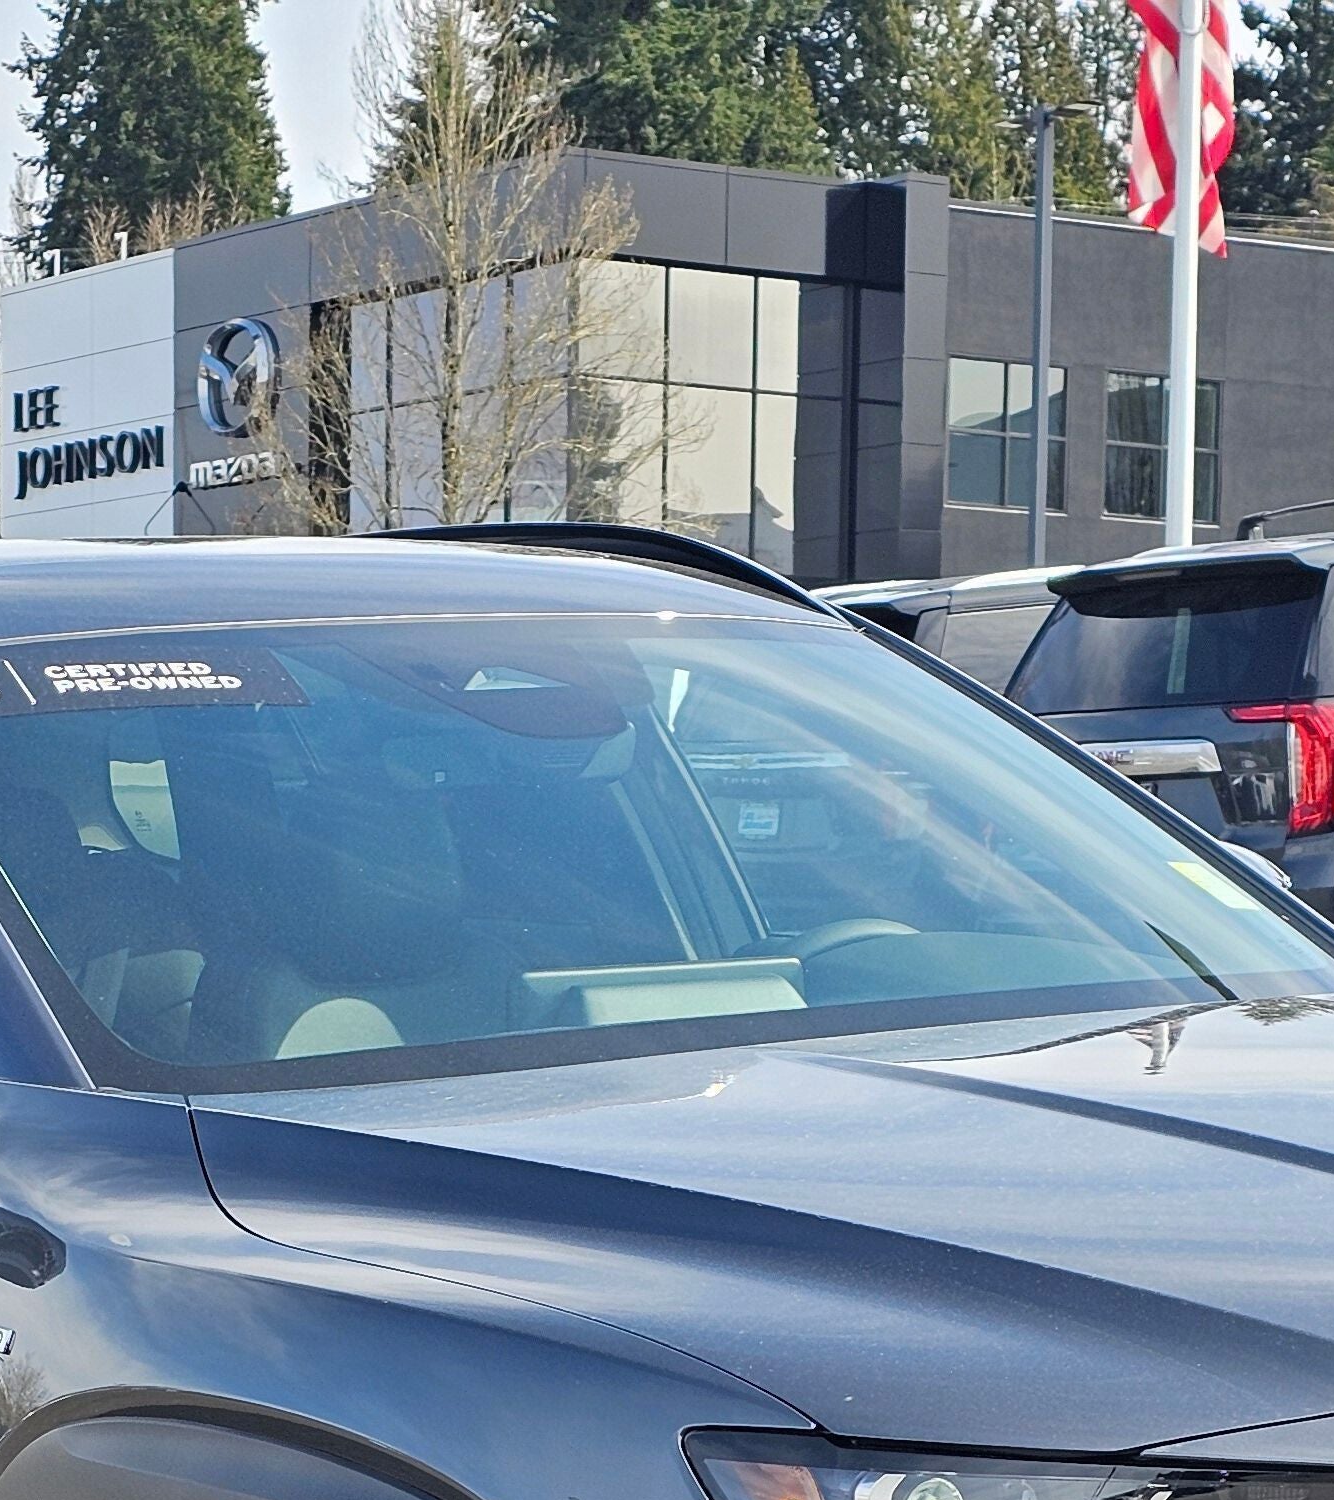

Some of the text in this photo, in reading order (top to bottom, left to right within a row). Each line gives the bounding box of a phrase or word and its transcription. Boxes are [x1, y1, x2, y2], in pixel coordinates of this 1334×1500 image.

[13, 385, 61, 432] LEE
[14, 425, 165, 500] JOHNSON
[44, 662, 212, 679] CERTIFIED
[53, 675, 242, 694] PRE-OWNED
